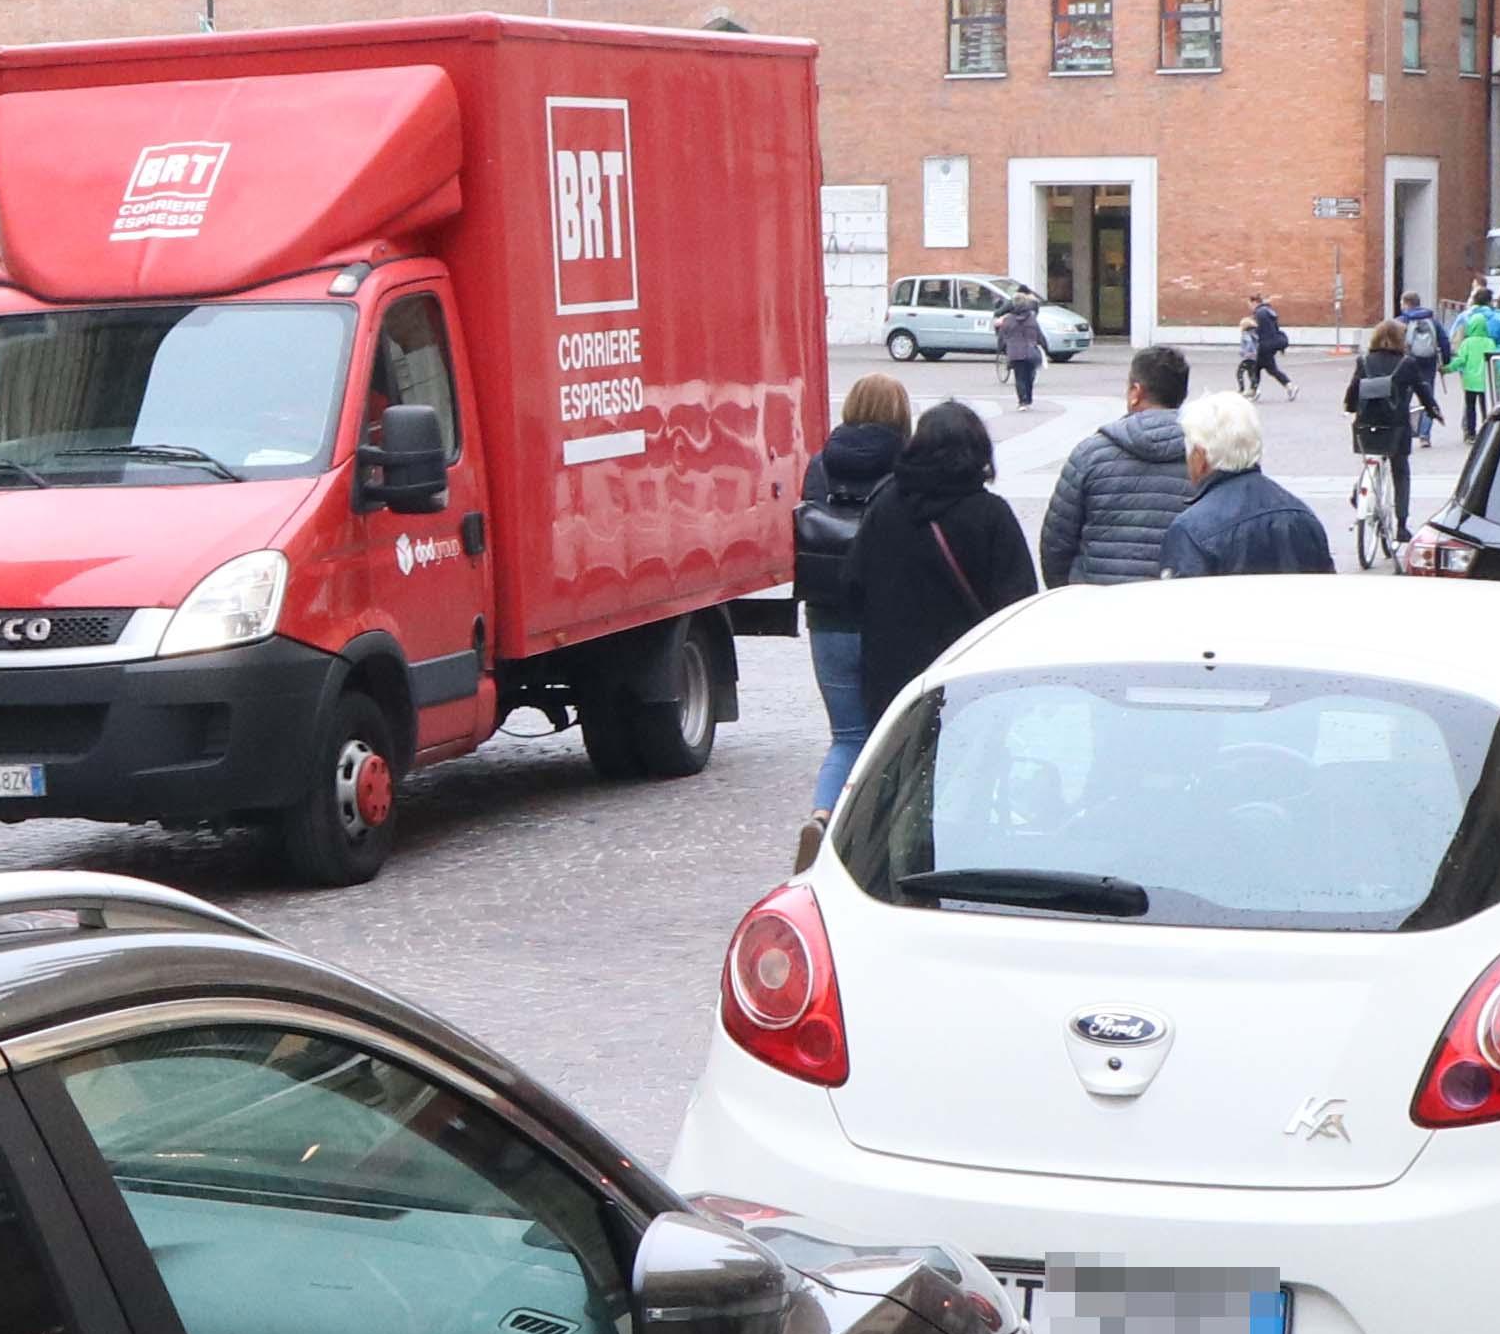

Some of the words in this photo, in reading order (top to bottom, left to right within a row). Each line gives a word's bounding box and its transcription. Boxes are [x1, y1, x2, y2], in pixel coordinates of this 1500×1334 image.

[136, 154, 218, 188] BRT
[113, 213, 204, 230] ESPRESSO
[119, 200, 209, 216] CORRIERE
[556, 150, 624, 260] BRT
[558, 328, 642, 372] CORRIERE
[560, 376, 644, 422] ESPRESSO
[1088, 1013, 1144, 1038] Ford
